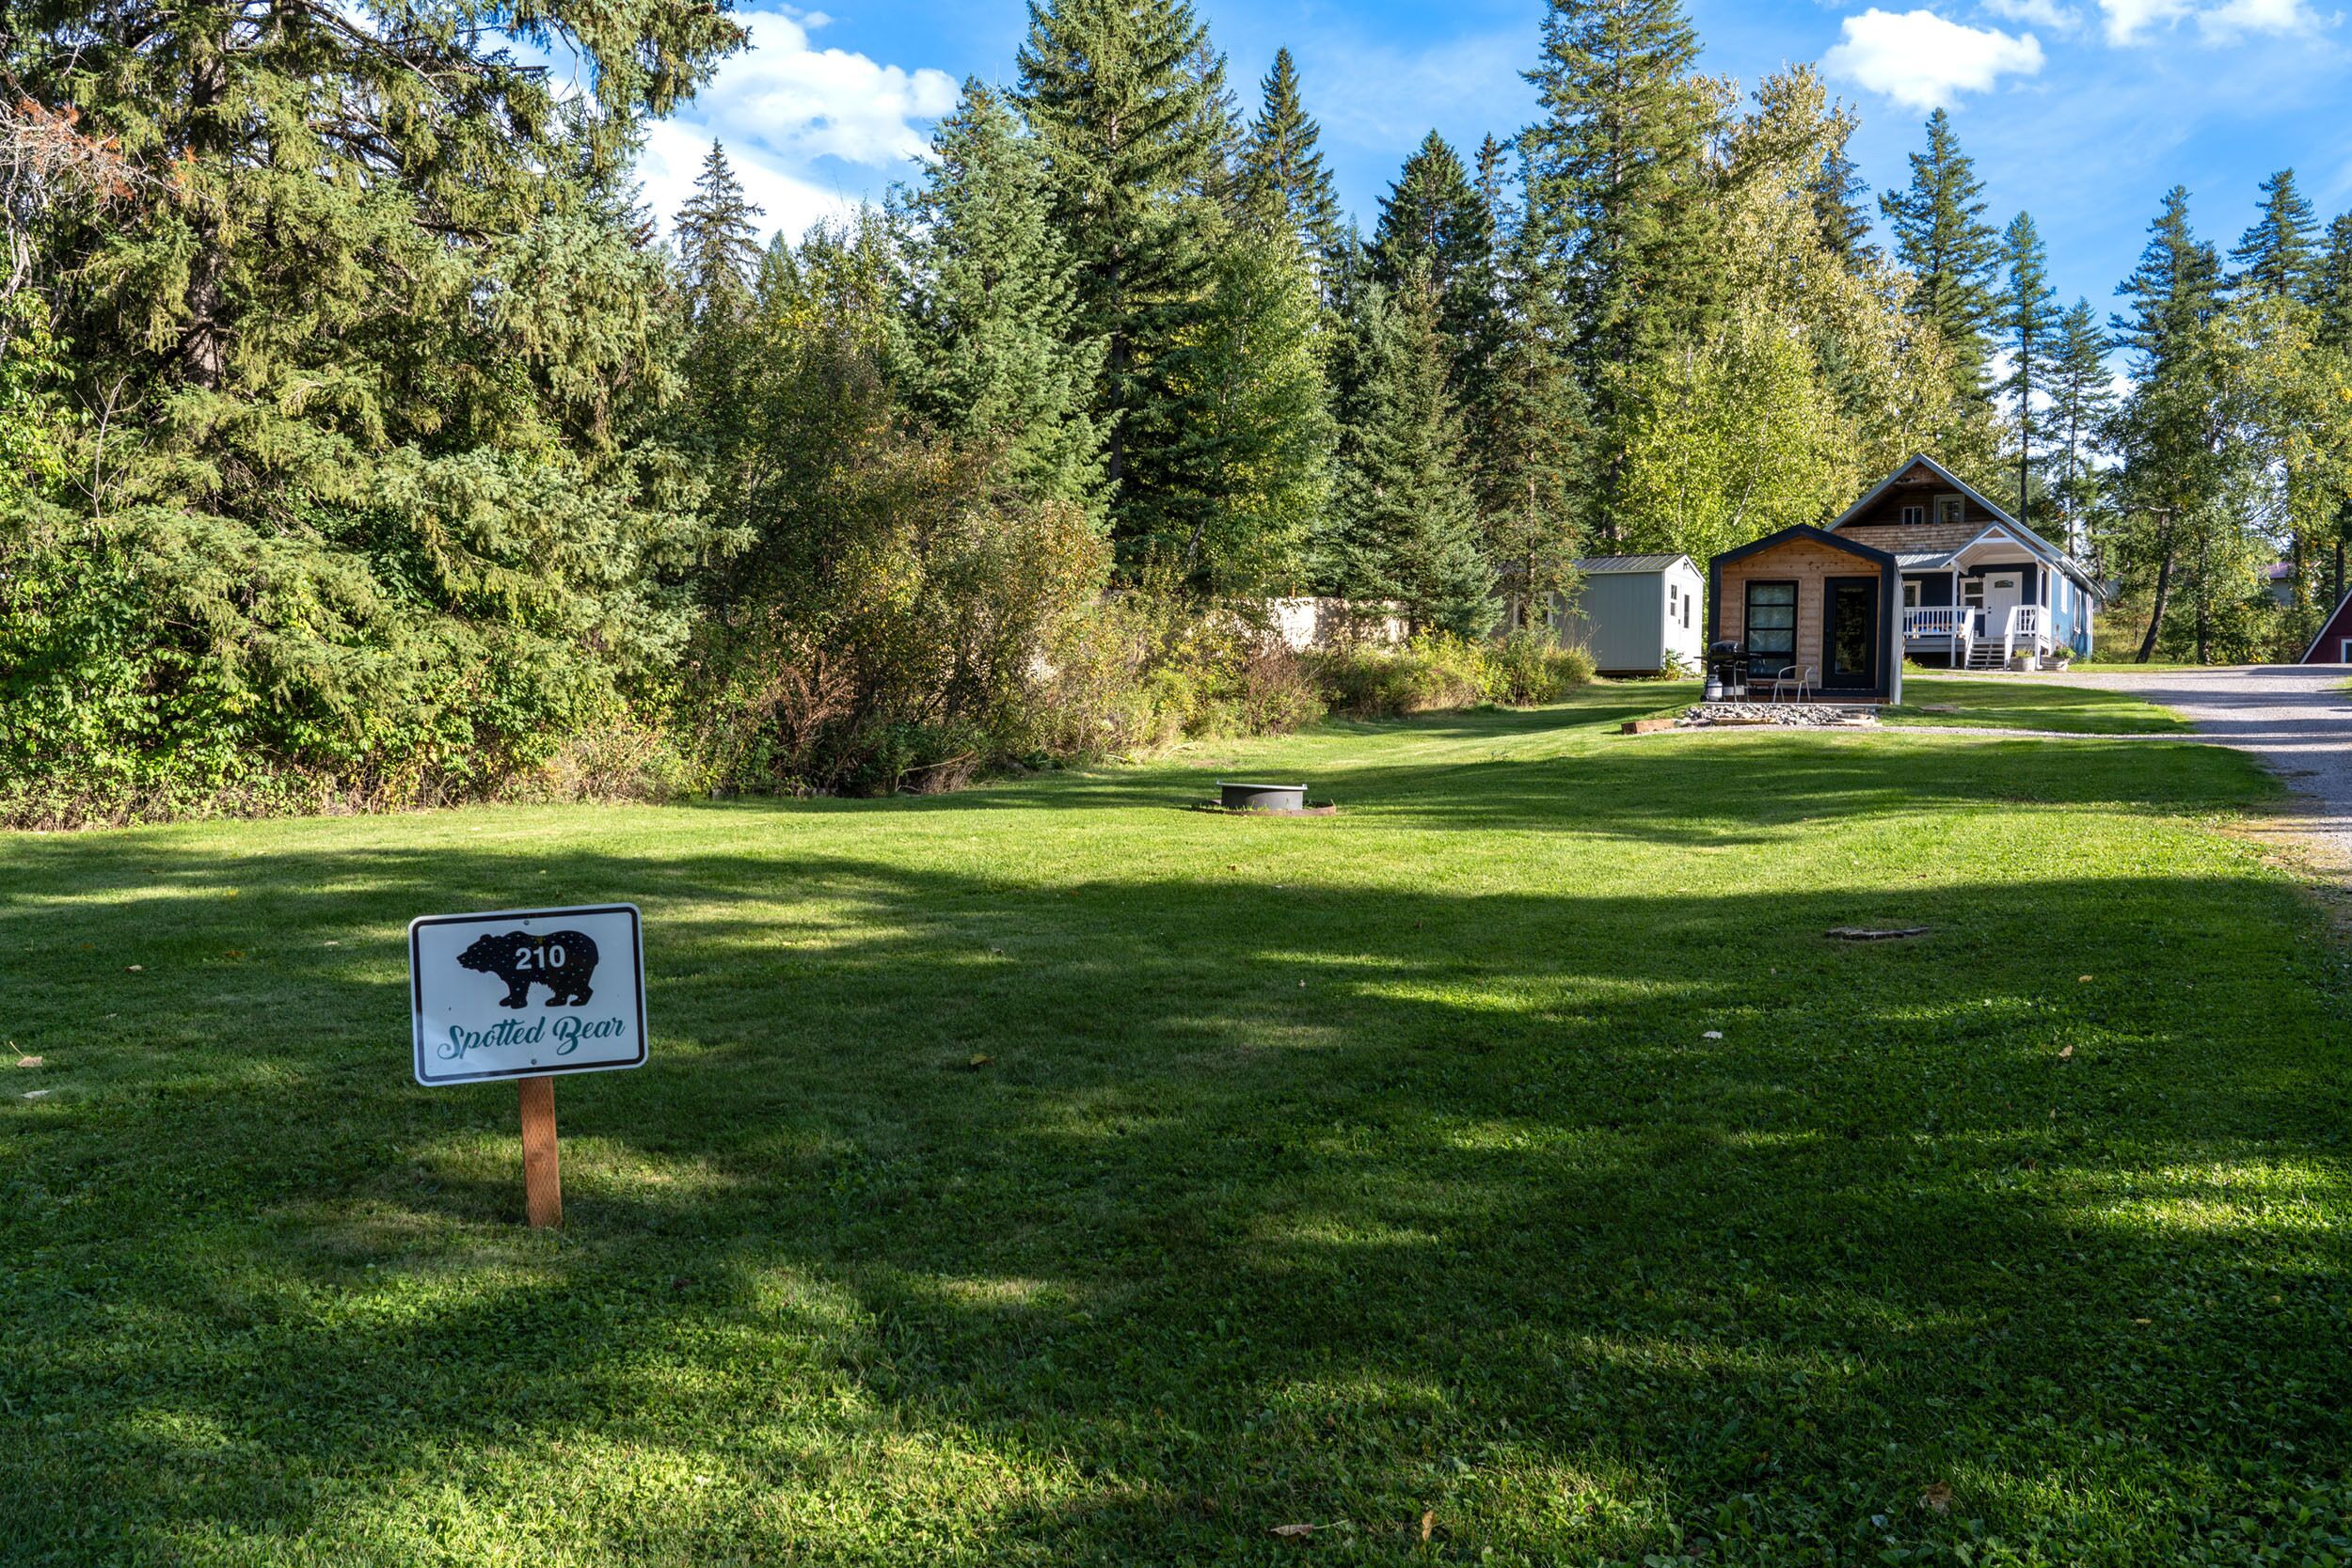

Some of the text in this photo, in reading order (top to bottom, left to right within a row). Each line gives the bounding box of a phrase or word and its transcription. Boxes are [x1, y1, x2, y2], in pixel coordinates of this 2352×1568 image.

[516, 945, 566, 970] 210
[437, 1016, 626, 1060] Spotted Bear
